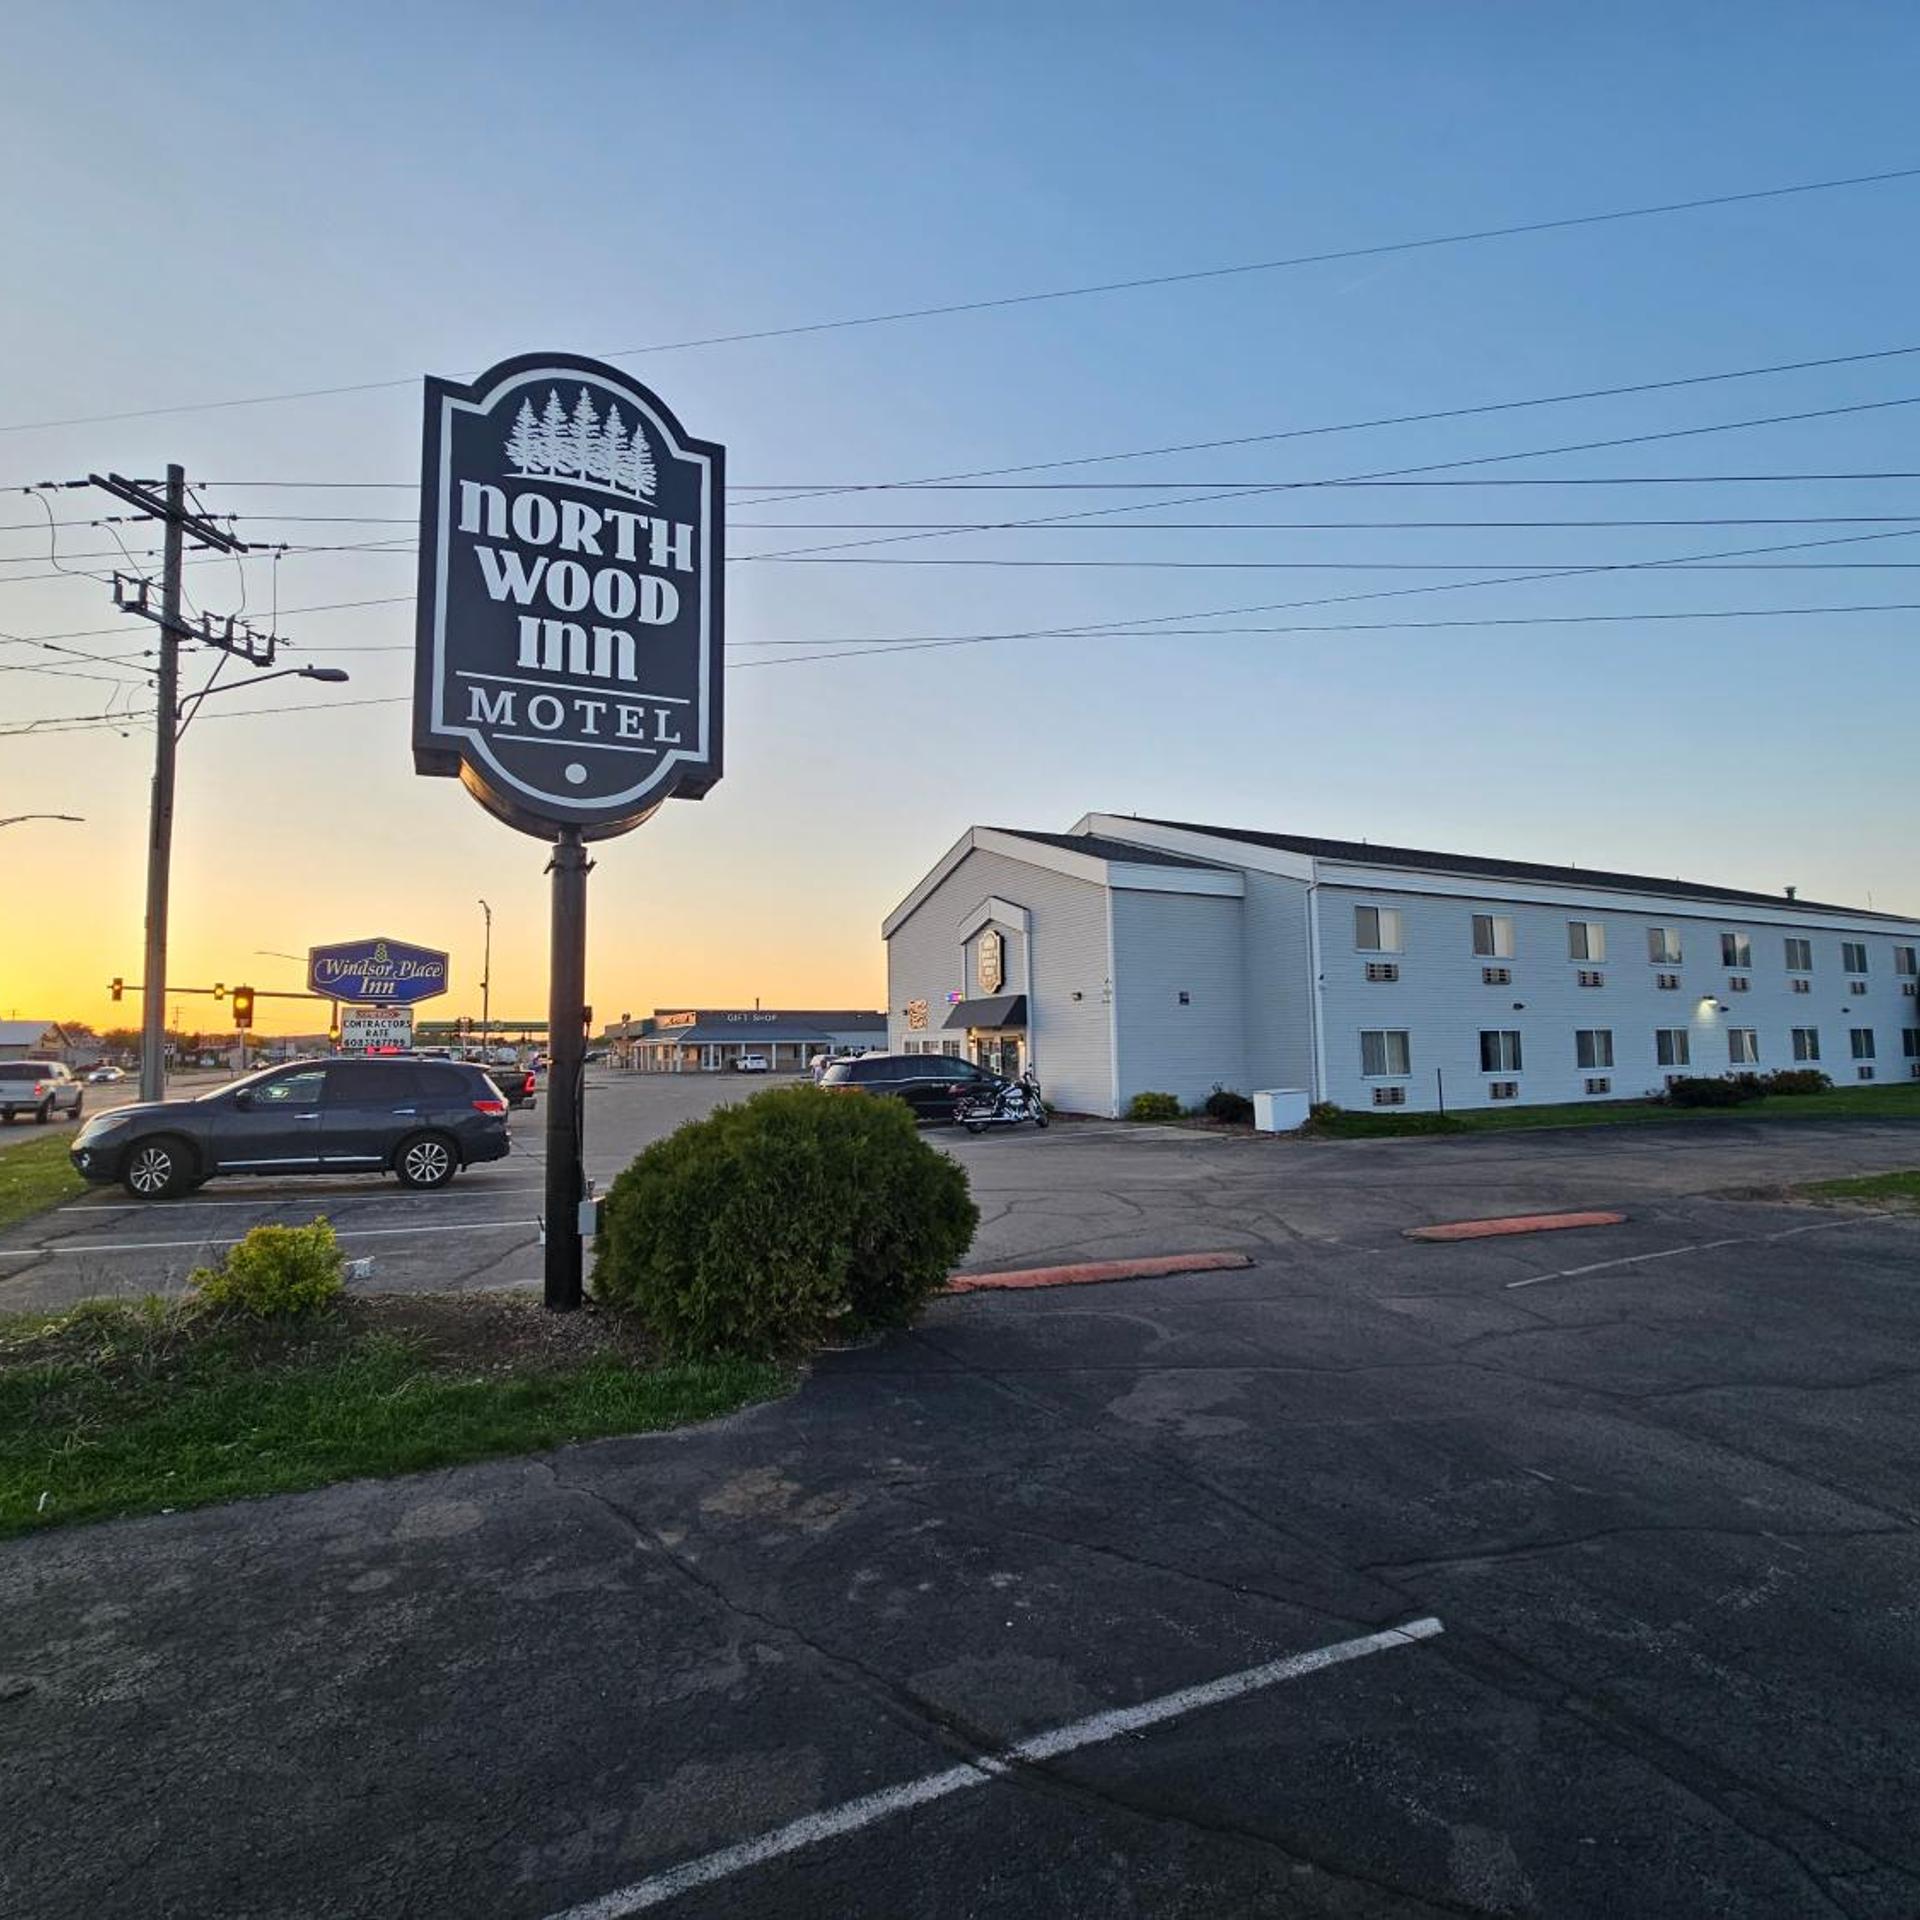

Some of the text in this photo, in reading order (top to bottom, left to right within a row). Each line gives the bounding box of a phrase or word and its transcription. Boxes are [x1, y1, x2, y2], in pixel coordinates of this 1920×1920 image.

[474, 545, 680, 626] WOOD
[466, 685, 681, 744] MOTEL
[318, 958, 443, 979] Windsor Place
[359, 977, 395, 994] Inn
[343, 1019, 411, 1028] CONTRACTORS
[365, 1028, 389, 1037] RATE
